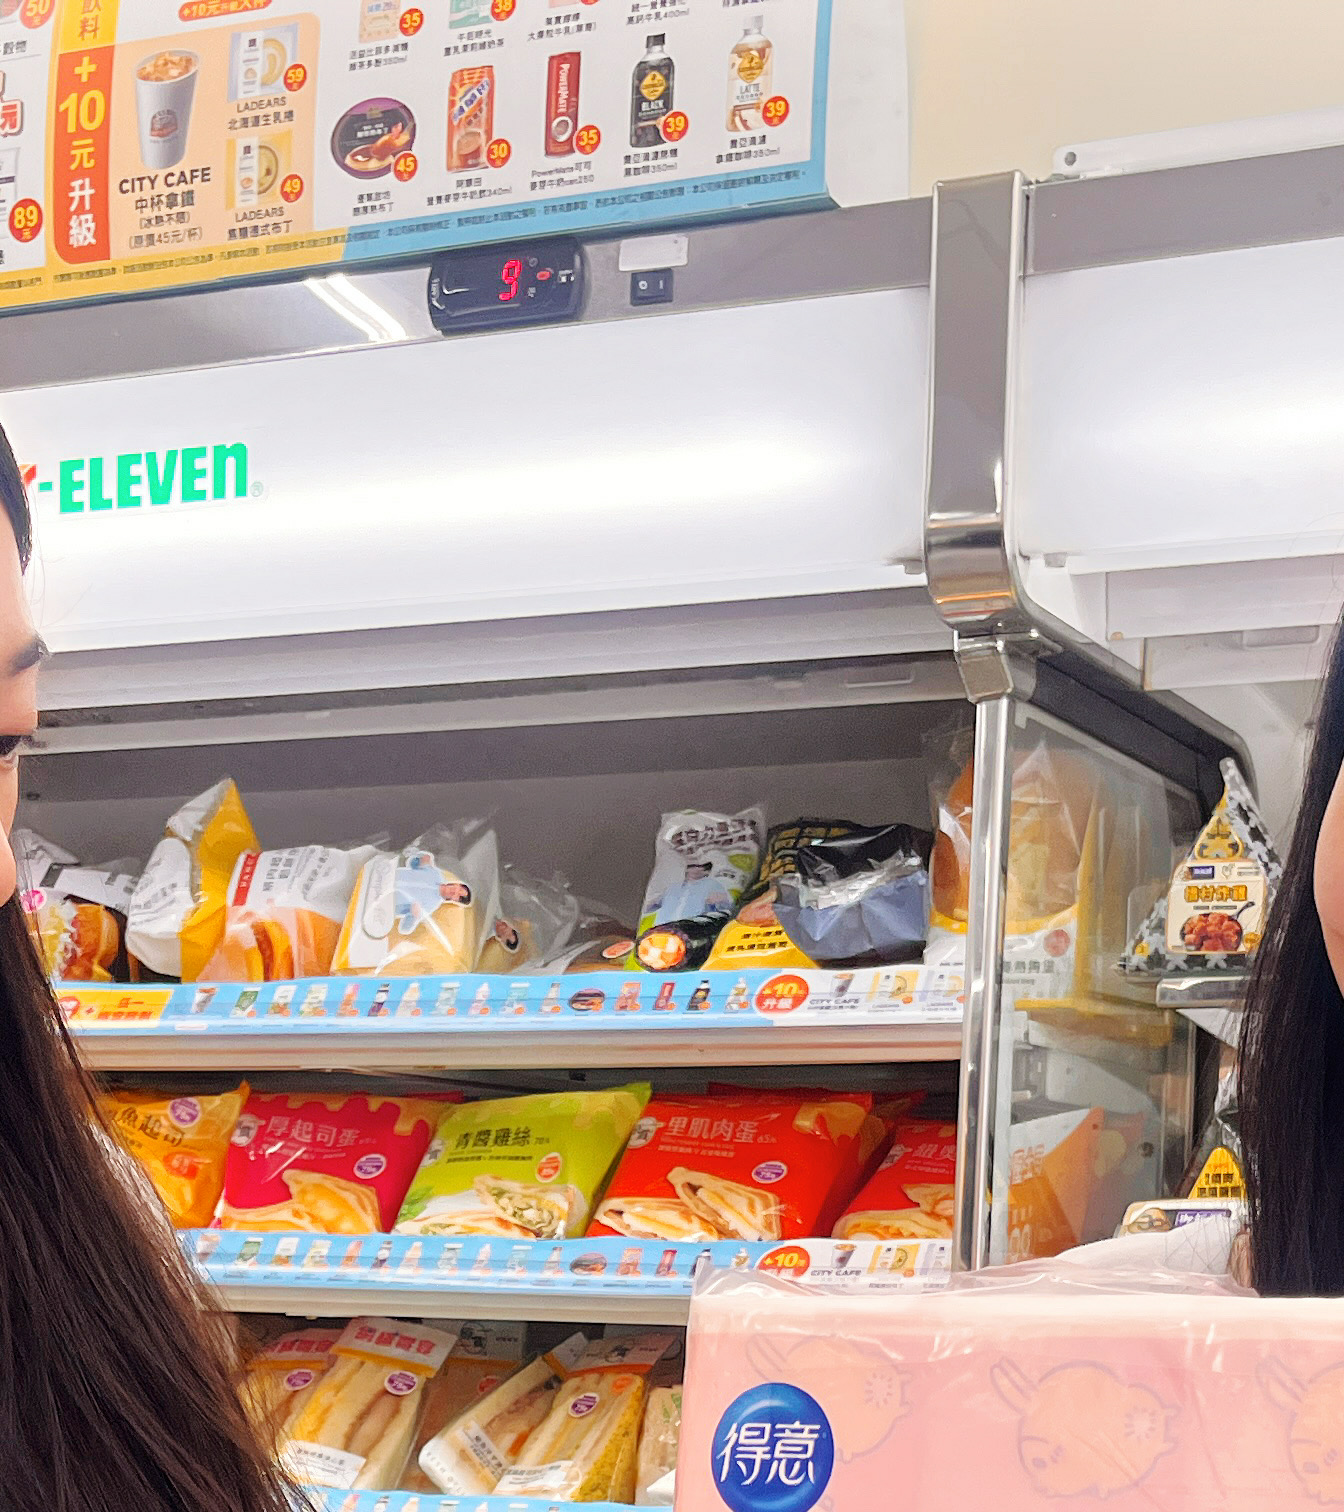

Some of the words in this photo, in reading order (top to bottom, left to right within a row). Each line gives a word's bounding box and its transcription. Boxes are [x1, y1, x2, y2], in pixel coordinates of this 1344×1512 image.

[402, 13, 421, 28] 35
[237, 96, 286, 113] LADEARS
[766, 101, 786, 117] 39
[666, 117, 685, 132] 39
[578, 130, 598, 146] 35
[490, 145, 507, 158] 30
[119, 171, 159, 194] CITY
[164, 166, 211, 188] CAFE
[13, 205, 39, 228] 89
[235, 206, 285, 222] LADEARS
[266, 1115, 360, 1149] 厚起司蛋
[667, 1116, 758, 1145] 里肌肉蛋
[716, 1420, 822, 1486] 得意
